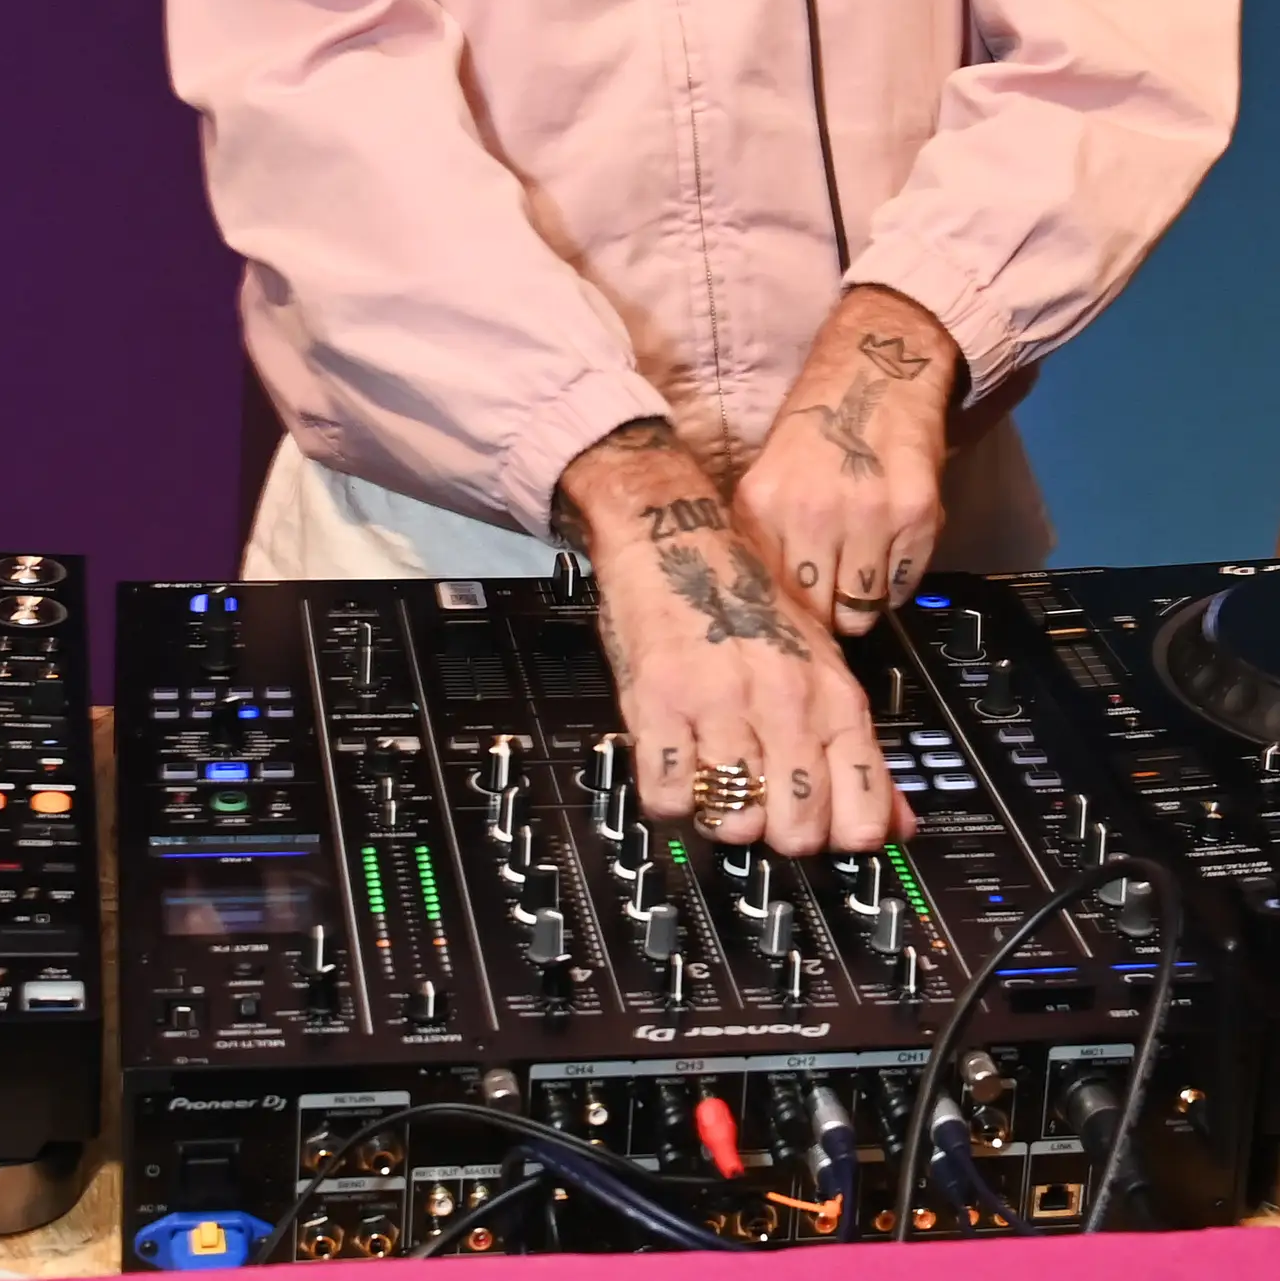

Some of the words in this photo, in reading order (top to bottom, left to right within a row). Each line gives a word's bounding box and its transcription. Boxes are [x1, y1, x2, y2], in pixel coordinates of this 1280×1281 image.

[686, 962, 712, 980] 3
[683, 1021, 831, 1040] Pioneer
[167, 1096, 257, 1112] Pioneer
